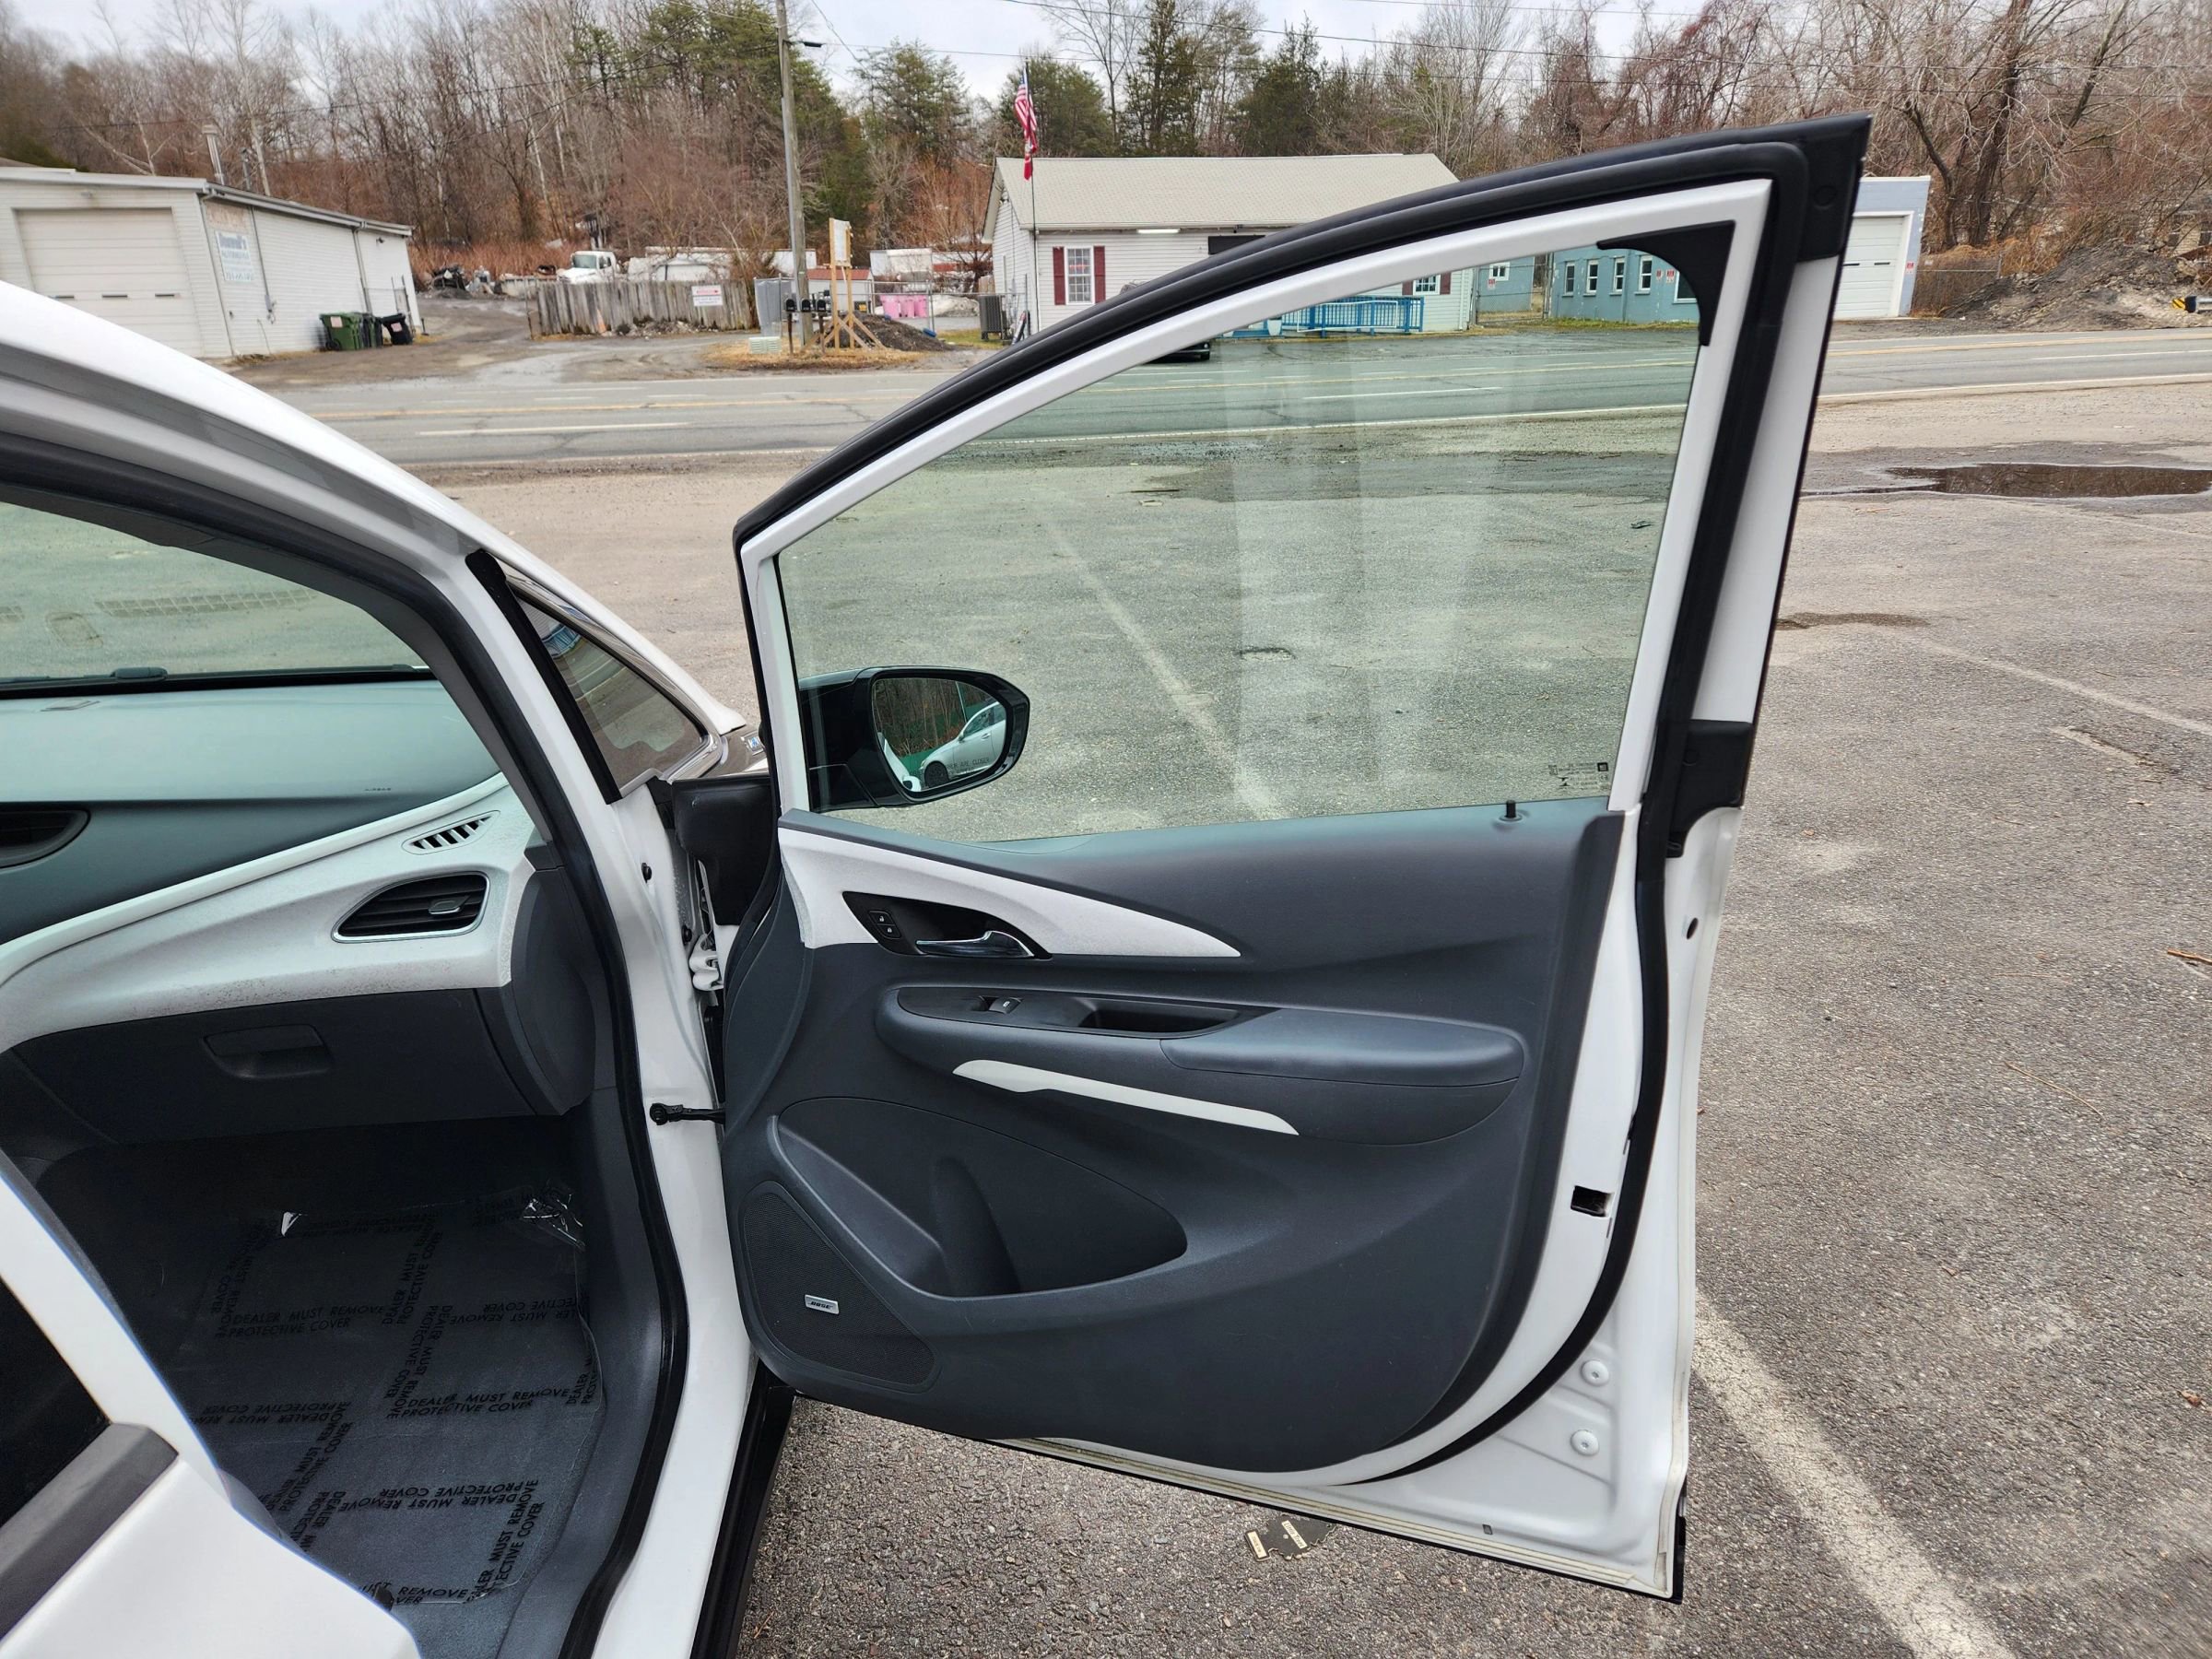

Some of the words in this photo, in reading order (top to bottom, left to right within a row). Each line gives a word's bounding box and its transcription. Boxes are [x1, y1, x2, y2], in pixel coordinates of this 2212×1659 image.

[399, 1253, 418, 1282] MUST
[396, 1264, 429, 1324] PROTECTIVE
[232, 1312, 281, 1325] DEALER
[288, 1307, 324, 1322] MUST
[329, 1305, 384, 1317] REMOVE
[483, 1301, 526, 1313] COVER
[229, 1323, 306, 1338] PROTECTIVE
[310, 1317, 352, 1332] COVER
[428, 1305, 453, 1340] DEALER
[449, 1313, 503, 1325] REMOVE
[510, 1312, 547, 1323] MUST
[406, 1305, 439, 1367] PROTECTIVE
[415, 1347, 433, 1376] MUST
[383, 1369, 410, 1398] COVER
[254, 1402, 338, 1414] PROTECTIVE
[386, 1380, 418, 1419] REMOVE
[408, 1394, 458, 1408] DEALER
[465, 1393, 506, 1403] MUST
[512, 1388, 570, 1401] REMOVE
[277, 1412, 330, 1424] DEALER
[401, 1402, 484, 1418] PROTECTIVE
[488, 1399, 535, 1413] COVER
[229, 1415, 271, 1424] MUST
[295, 1446, 322, 1472] MUST
[316, 1401, 352, 1441] REMOVE
[277, 1456, 330, 1512] PROTECTIVE
[324, 1421, 354, 1453] COVER
[379, 1487, 429, 1499] COVER
[434, 1480, 524, 1498] PROTECTIVE
[312, 1491, 347, 1527] DEALER
[337, 1497, 403, 1512] REMOVE
[407, 1498, 453, 1510] MUST
[461, 1493, 518, 1506] DEALER
[488, 1530, 513, 1561] MUST
[507, 1479, 538, 1524] REMOVE
[517, 1501, 546, 1537] COVER
[395, 1595, 424, 1605] VER
[397, 1586, 469, 1599] REMOVE
